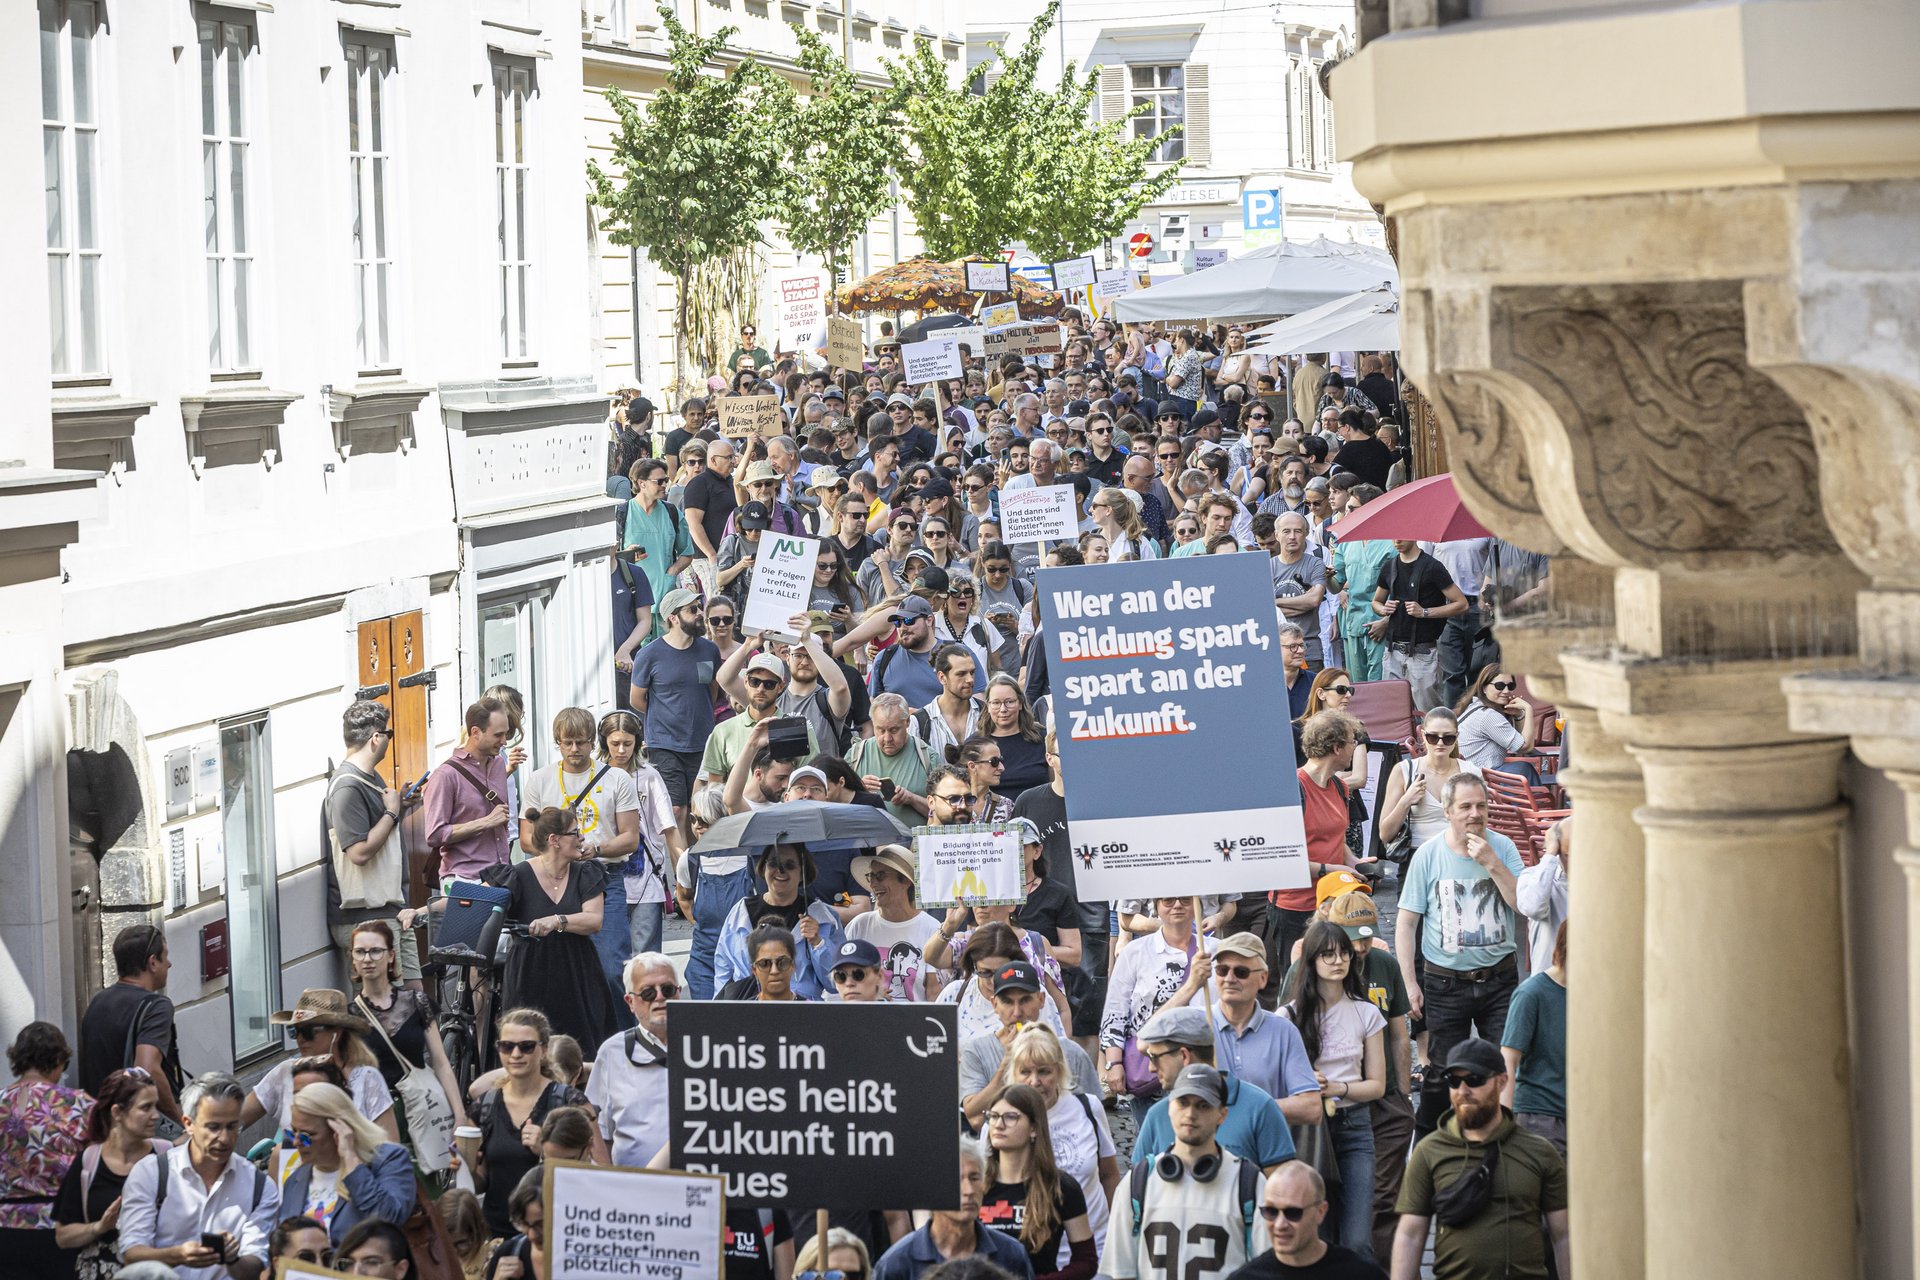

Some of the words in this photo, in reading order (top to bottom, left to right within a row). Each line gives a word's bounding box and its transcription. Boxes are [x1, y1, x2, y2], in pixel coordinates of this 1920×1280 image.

[1170, 189, 1225, 201] WIESEL
[1248, 193, 1274, 228] P
[782, 278, 819, 291] WIDER-
[785, 288, 817, 301] STAND
[790, 303, 814, 312] GEGEN
[784, 313, 799, 321] DAS
[789, 319, 817, 328] DIKTAT!
[797, 333, 812, 342] KSV
[984, 334, 1007, 345] BILDU
[911, 372, 935, 381] plötzlich
[725, 401, 755, 413] Wissen
[1020, 515, 1046, 523] besten
[1009, 530, 1042, 539] plötzlich
[761, 566, 776, 576] Die
[777, 569, 806, 581] Folgen
[767, 578, 797, 589] treffen
[759, 587, 774, 595] uns
[776, 589, 801, 600] ALLE!
[1053, 589, 1114, 619] Wer
[1120, 589, 1158, 615] an
[1163, 580, 1216, 612] der
[1058, 625, 1175, 660] Bildung
[1179, 618, 1270, 657] spart,
[1064, 667, 1146, 706] spart
[1151, 667, 1189, 693] an
[1193, 659, 1246, 690] der
[1069, 702, 1197, 739] Zukunft.
[942, 841, 971, 849] Bildung
[1101, 841, 1129, 854] GÖD
[1239, 835, 1265, 847] GÖD
[682, 1035, 767, 1070] Unis
[778, 1036, 826, 1070] im
[684, 1077, 787, 1112] Blues
[799, 1079, 897, 1114] heißt
[682, 1120, 836, 1156] Zukunft
[847, 1122, 894, 1156] im
[685, 1163, 789, 1199] ues
[686, 1185, 713, 1194] kunst
[686, 1199, 707, 1208] graz
[564, 1205, 601, 1221] Und
[606, 1208, 650, 1226] dann
[655, 1212, 692, 1228] sind
[564, 1222, 591, 1239] die
[596, 1225, 655, 1242] besten
[735, 1232, 755, 1246] TU
[1143, 1221, 1230, 1280] 92
[563, 1256, 641, 1275] plötzlich
[646, 1264, 683, 1280] weg
